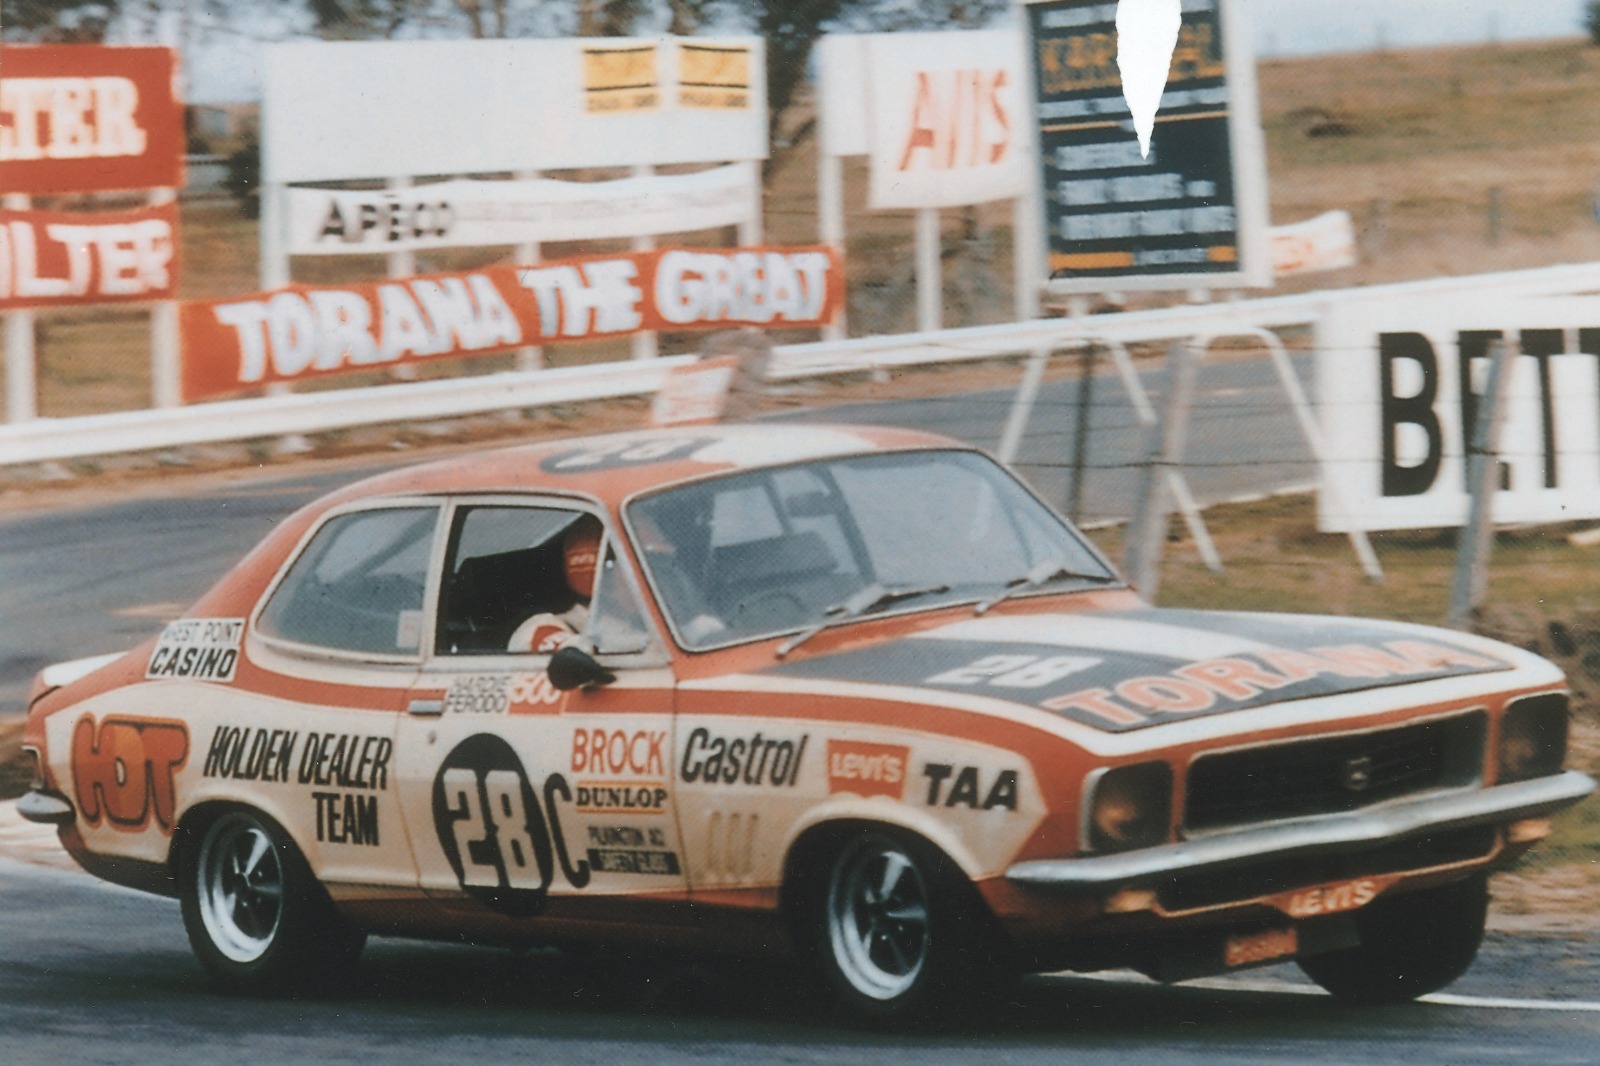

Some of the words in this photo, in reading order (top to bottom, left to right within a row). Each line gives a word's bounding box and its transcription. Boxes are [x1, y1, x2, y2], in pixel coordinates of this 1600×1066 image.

[0, 76, 148, 162] TER
[214, 274, 522, 383] TORANA
[516, 258, 643, 337] THE
[656, 249, 831, 325] GREAT
[148, 646, 238, 679] CASINO
[927, 654, 1104, 689] 28
[1042, 640, 1497, 725] TORANA
[203, 725, 299, 784] HOLDEN
[298, 731, 393, 791] DEALER
[571, 728, 666, 775] BROCK
[680, 727, 810, 787] Castrol
[576, 786, 668, 808] DUNLOP
[924, 763, 1018, 812] TAA
[311, 791, 380, 847] TEAM
[443, 767, 543, 890] 28
